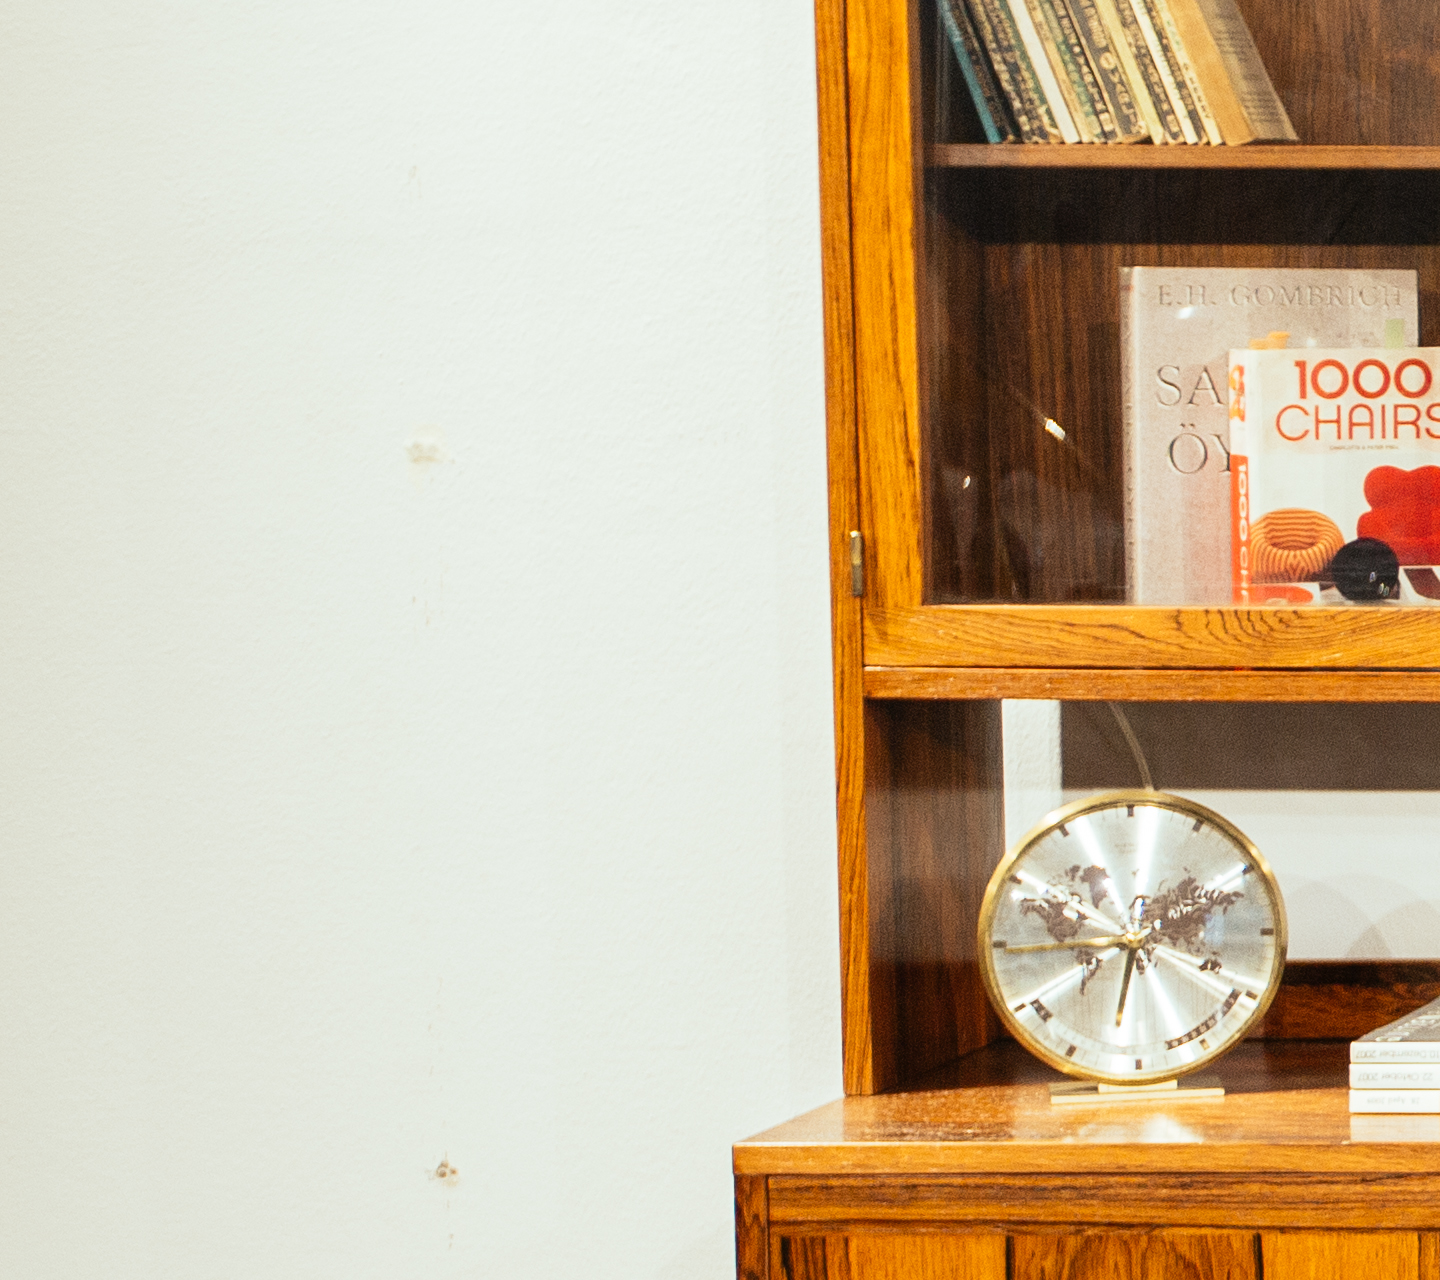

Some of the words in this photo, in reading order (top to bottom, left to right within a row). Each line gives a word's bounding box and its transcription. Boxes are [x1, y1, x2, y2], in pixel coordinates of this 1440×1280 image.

[1158, 285, 1215, 307] E.H.
[1230, 284, 1402, 308] GOMBRICH
[1155, 365, 1226, 407] SA
[1294, 358, 1433, 400] 1000
[1169, 422, 1230, 474] ÖY
[1237, 464, 1248, 542] 1000
[1355, 1049, 1376, 1058] 2007
[1378, 1049, 1426, 1058] Dezember
[1357, 1072, 1377, 1080] 2007
[1381, 1072, 1419, 1081] Oktober
